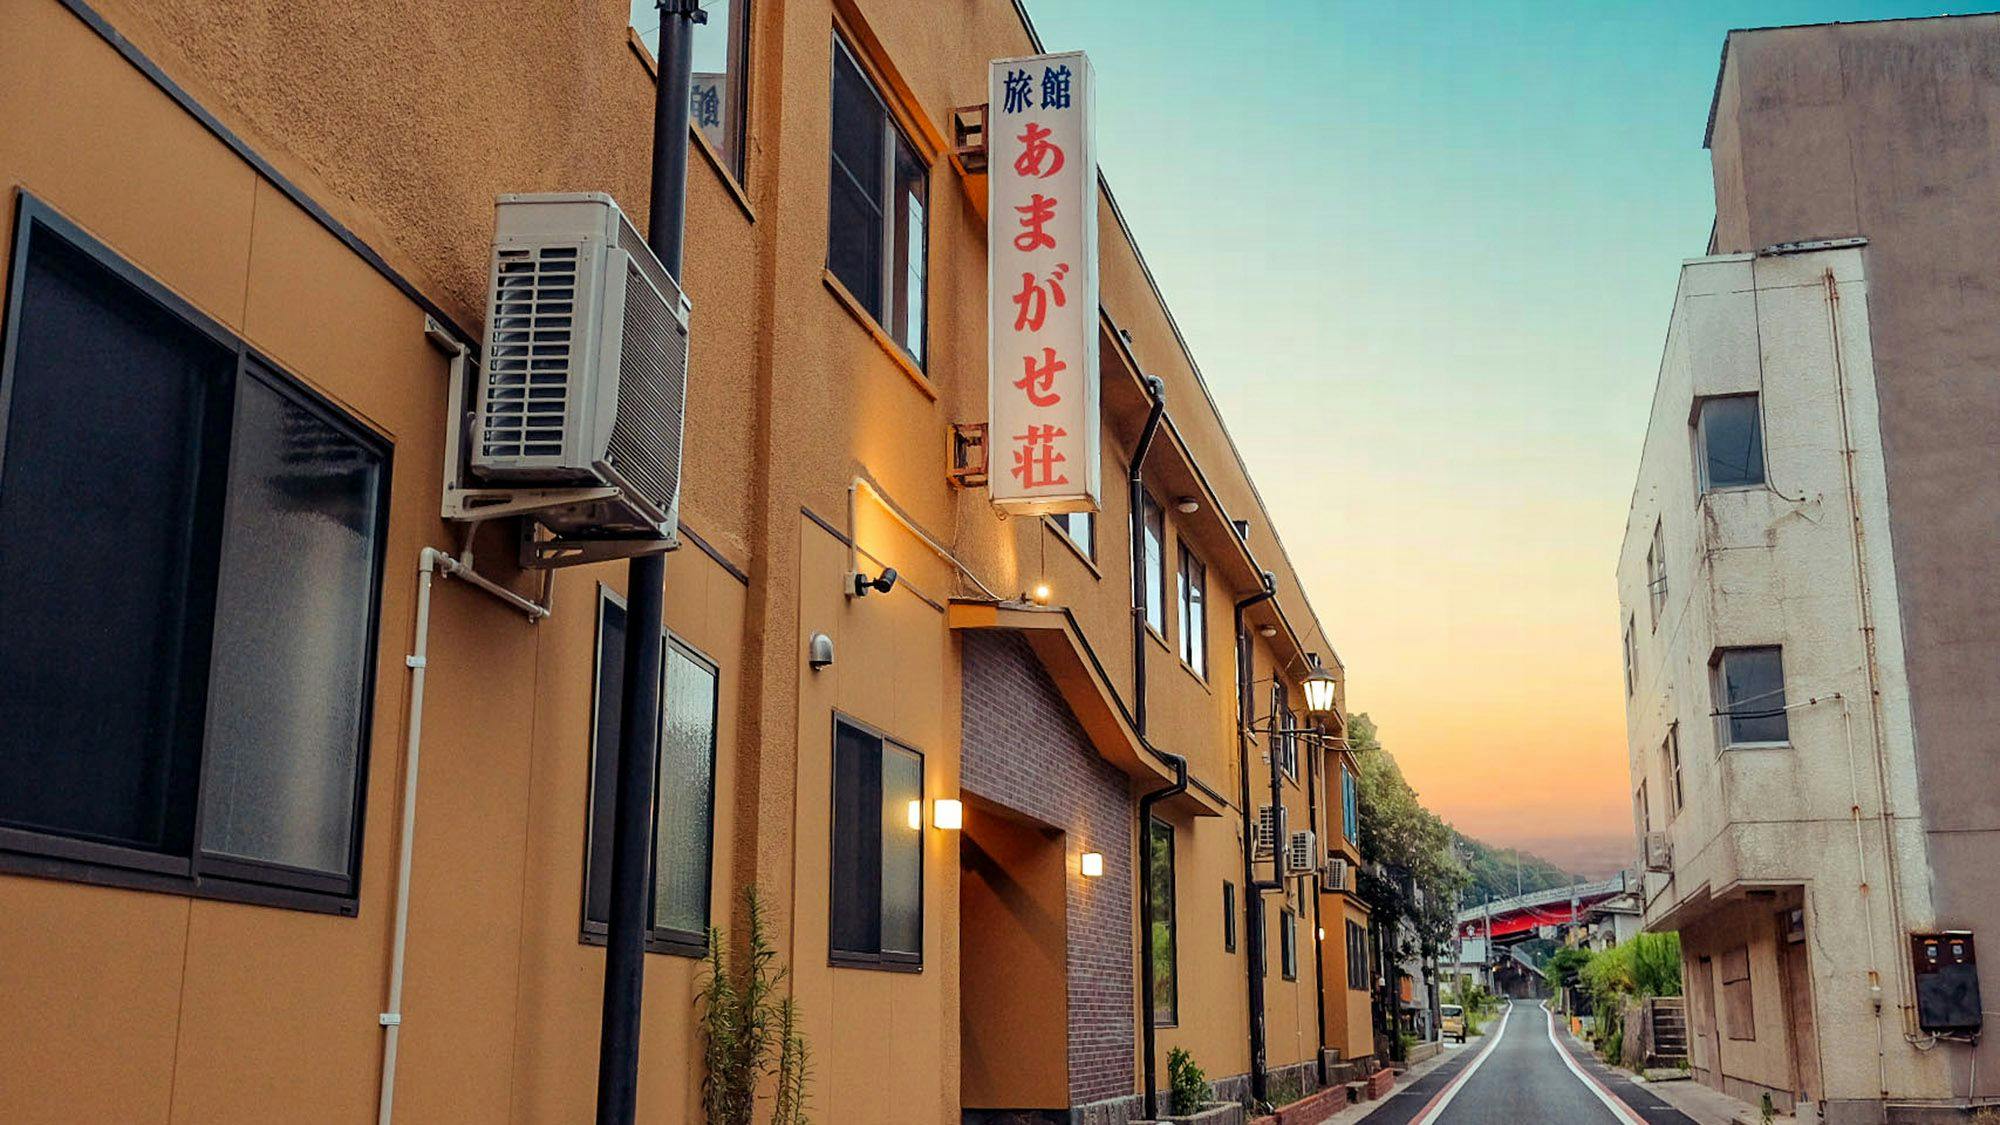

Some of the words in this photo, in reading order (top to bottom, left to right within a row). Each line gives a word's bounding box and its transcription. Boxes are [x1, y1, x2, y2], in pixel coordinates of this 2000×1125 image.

[1003, 64, 1072, 114] 旅館
[1012, 122, 1069, 489] あまがせ荘
